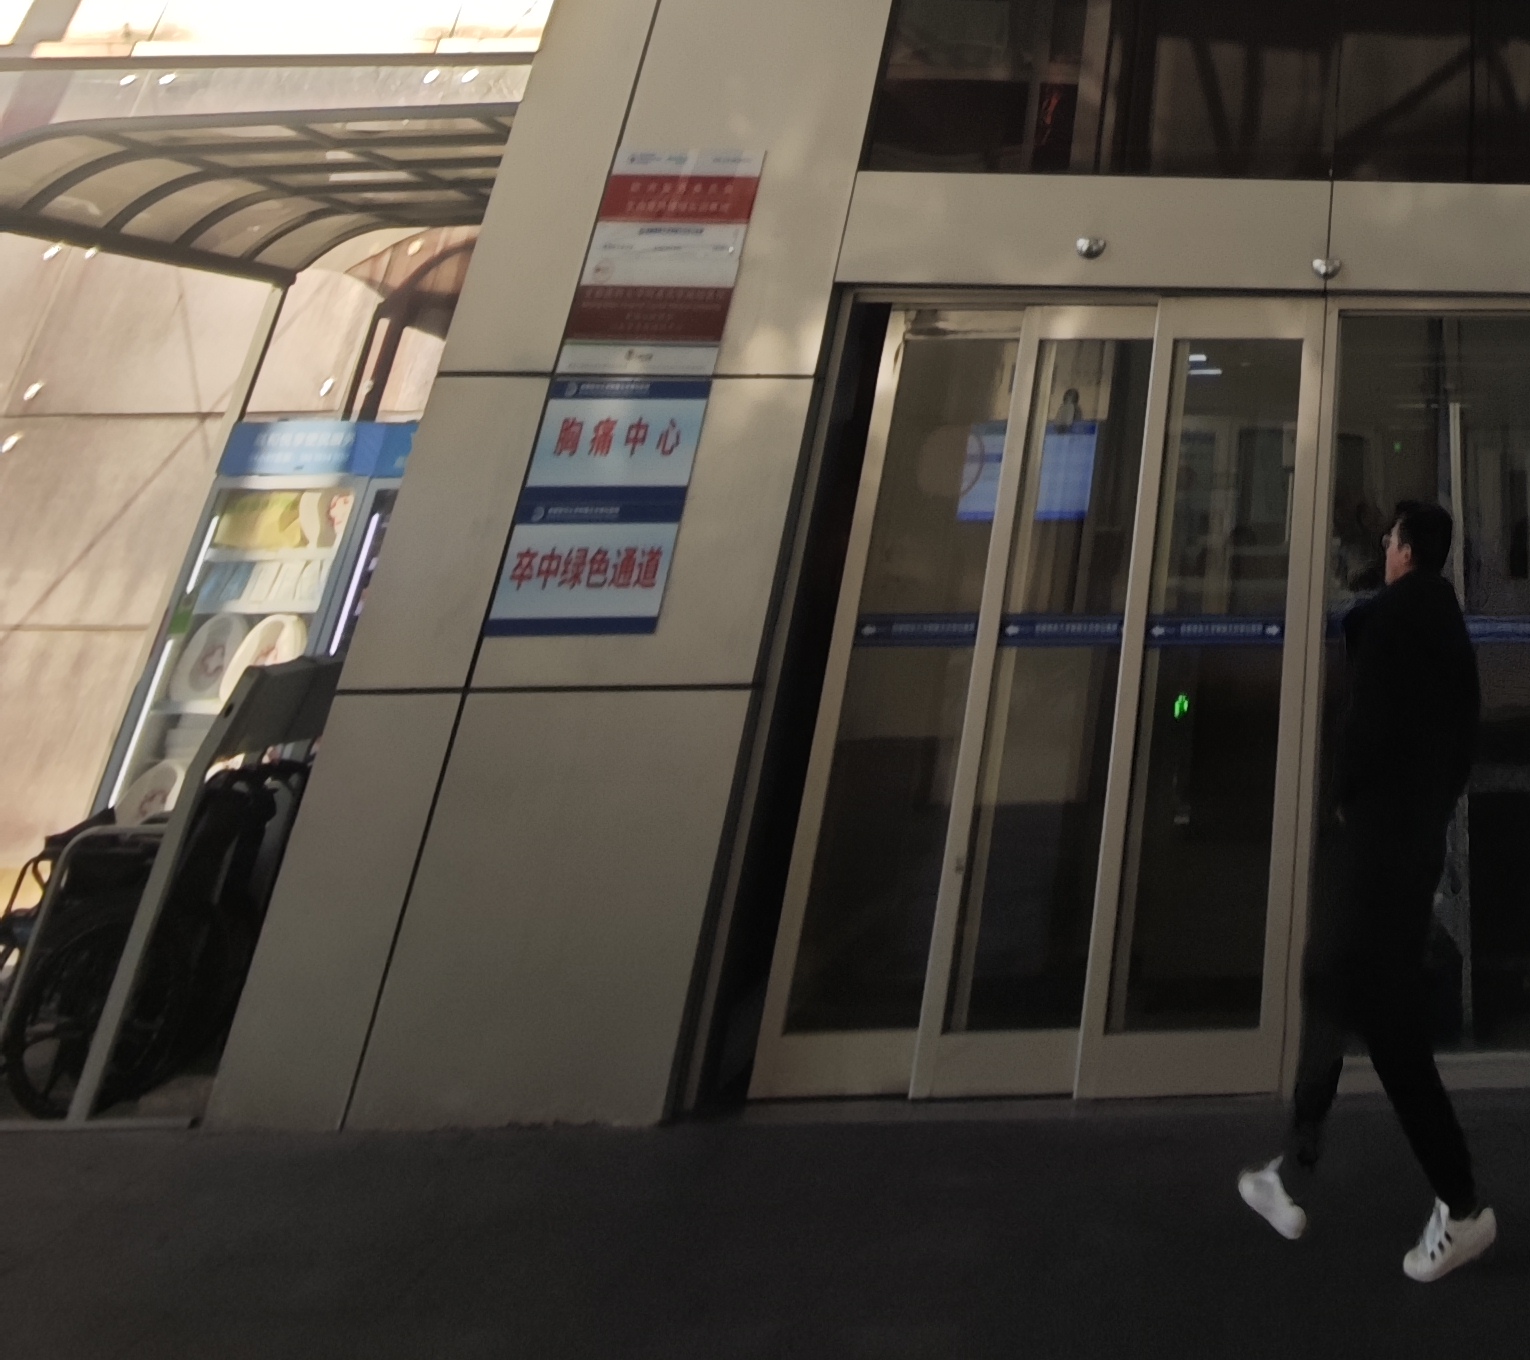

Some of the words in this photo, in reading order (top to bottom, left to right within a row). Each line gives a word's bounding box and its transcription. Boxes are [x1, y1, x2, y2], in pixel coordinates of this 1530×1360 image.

[553, 416, 681, 457] 胸痛中心
[510, 546, 663, 591] 卒中绿色通道
